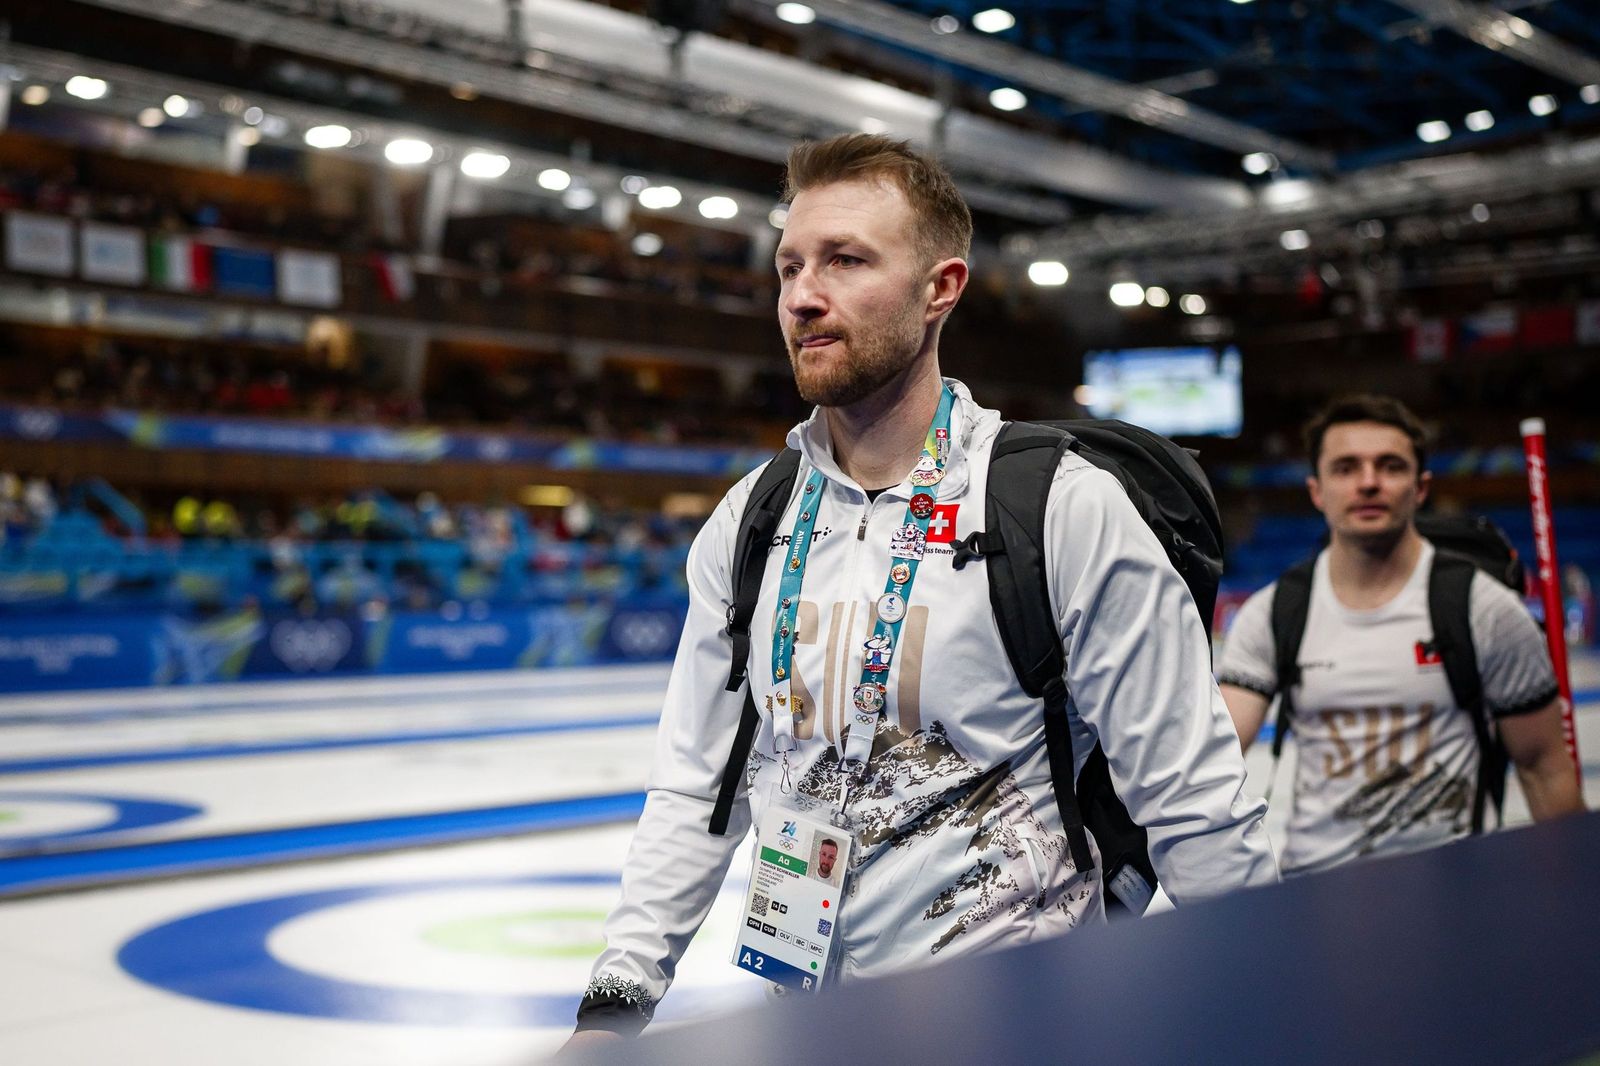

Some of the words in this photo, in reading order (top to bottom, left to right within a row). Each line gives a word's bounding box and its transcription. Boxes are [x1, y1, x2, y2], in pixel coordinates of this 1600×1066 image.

[771, 531, 822, 547] CRT
[935, 547, 954, 555] team
[778, 856, 790, 866] Aa
[763, 925, 775, 934] CUR
[779, 932, 790, 940] OLV
[810, 945, 822, 953] MPC
[741, 952, 752, 966] A
[754, 956, 764, 970] 2
[802, 976, 812, 992] R
